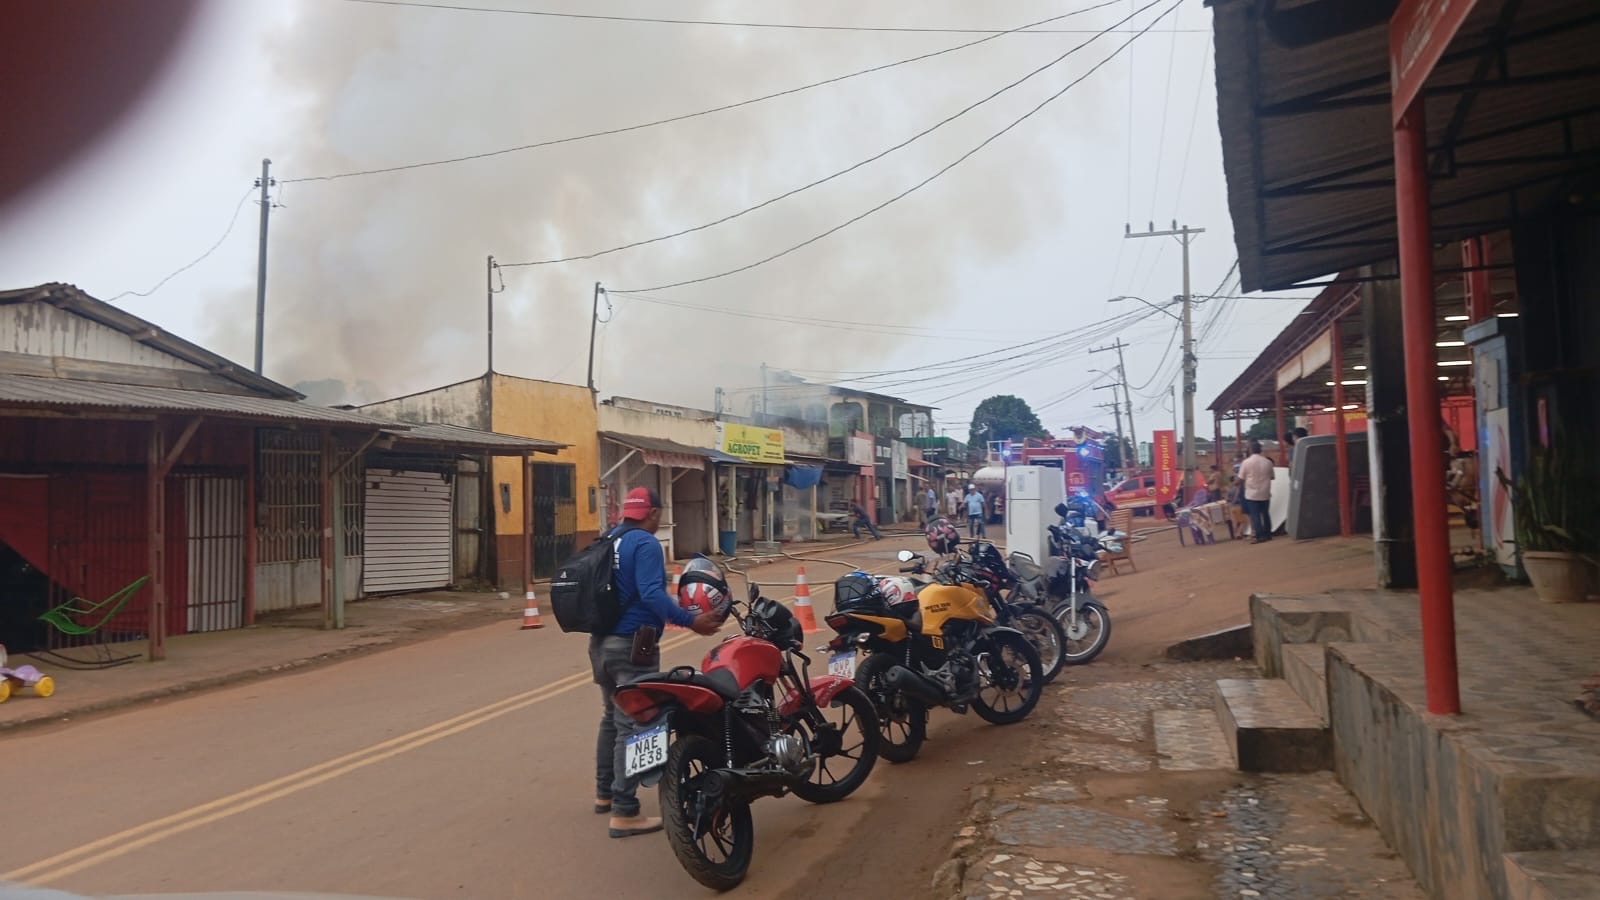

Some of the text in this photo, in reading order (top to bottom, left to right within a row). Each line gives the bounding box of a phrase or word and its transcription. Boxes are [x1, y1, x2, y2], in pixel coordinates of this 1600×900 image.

[728, 442, 760, 456] AGROPET
[635, 735, 658, 756] NAE
[632, 747, 662, 770] 4E38
